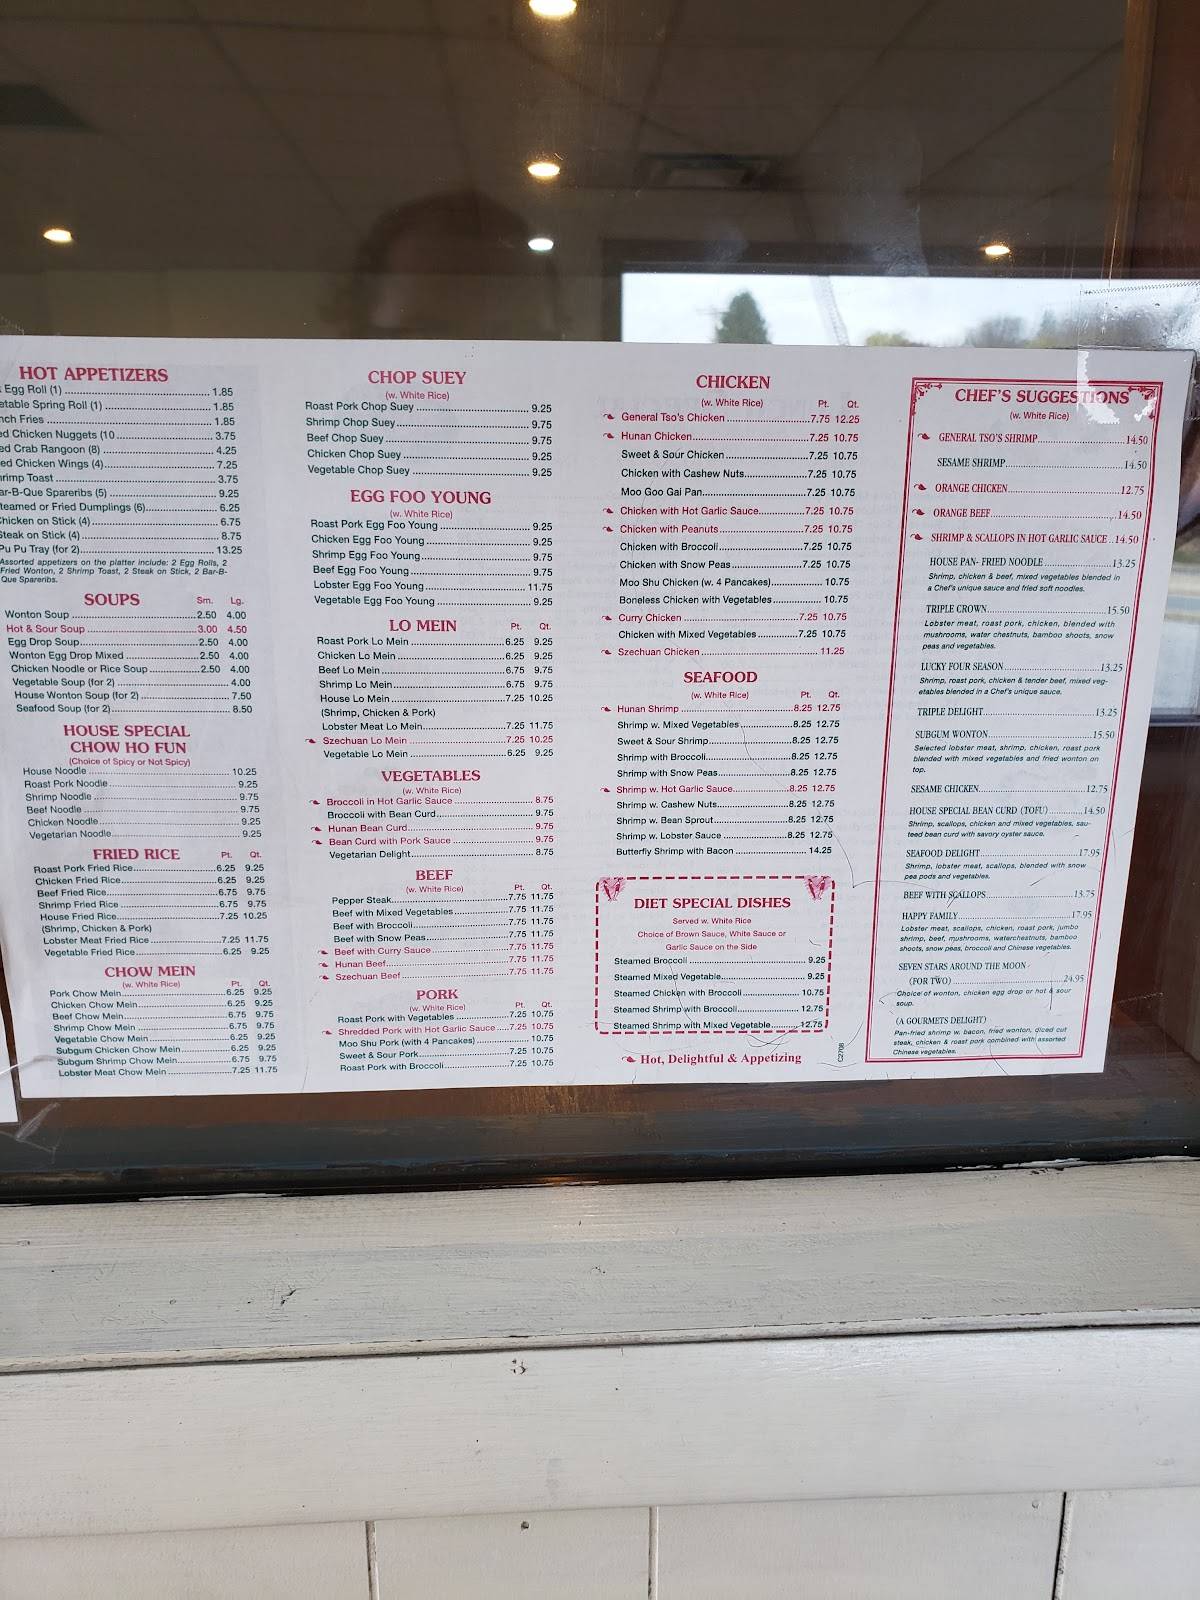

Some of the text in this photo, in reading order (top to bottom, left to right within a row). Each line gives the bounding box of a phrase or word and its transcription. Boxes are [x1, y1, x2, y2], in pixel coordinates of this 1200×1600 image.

[18, 365, 169, 383] HOT APPETIZERS
[367, 370, 467, 385] CHOP SUEY
[695, 374, 771, 390] CHICKEN
[385, 390, 450, 402] (w. White Rice)
[954, 387, 1130, 405] CHEF'S SUGGESTIONS
[621, 411, 860, 425] General Tso's Chicken 7.75 12.25
[938, 432, 1149, 447] GENERAL TSO'S SHRIMP 14.50
[13, 443, 39, 454] Crab
[40, 443, 86, 456] Rangoon
[87, 444, 101, 456] (8)
[215, 445, 237, 456] 4.25
[350, 489, 492, 505] EGG FOO YOUNG
[929, 557, 959, 567] HOUSE
[981, 557, 1007, 567] FRIED
[1008, 557, 1044, 568] NOODLE
[1112, 558, 1136, 569] 13.25
[313, 579, 553, 593] Lobster Egg Foo Young 11.75
[933, 583, 957, 592] Chef's
[957, 584, 982, 593] unique
[1005, 583, 1021, 592] and
[1021, 584, 1039, 593] fried
[1039, 584, 1054, 592] soft
[1054, 584, 1085, 593] noodles.
[83, 593, 245, 607] SOUPS Sm. Lg.
[5, 623, 248, 636] Hot & Sour Soup 3.00 4.50
[389, 619, 552, 633] LO MEIN Pt. Qt.
[618, 629, 847, 641] Chicken with Mixed Vegetables 7.25 10.75
[317, 650, 554, 661] Chicken Lo Mein 6.25 9.25
[10, 663, 251, 675] Chicken Noodle or Rice Soup 2.50 4.00
[683, 671, 758, 684] SEAFOOD
[63, 724, 191, 738] HOUSE SPECIAL
[70, 741, 187, 754] CHOW HO FUN
[68, 757, 191, 768] (Choice of Spicy or Not Spicy)
[381, 769, 481, 783] VEGETABLES
[326, 795, 554, 807] Broccoli in Hot Garlic Sauce 8.75
[92, 848, 262, 861] FRIED RICE Pt. Qt.
[616, 846, 832, 857] Butterfly Shrimp with Bacon 14.25
[33, 863, 265, 875] Roast Pork Fried Rice 6.25 9.25
[415, 869, 454, 881] BEEF
[331, 892, 554, 906] Pepper Steak 7.75 11.75
[633, 897, 792, 910] DIET SPECIAL DISHES
[672, 917, 700, 925] Served
[711, 917, 734, 925] White
[734, 917, 752, 925] Rice
[901, 909, 1093, 921] HAPPY FAMILY 17.95
[104, 965, 196, 979] CHOW MEIN
[898, 961, 1027, 971] SEVEN STARS AROUND THE MOON
[613, 972, 825, 982] Steamed Mixed Vegetable 9.25
[416, 988, 459, 1001] PORK
[338, 1033, 554, 1048] Moo Shu Pork (with 4 Pancakes) 10.75
[640, 1051, 802, 1066] Hot, Delightful & Appetizing
[58, 1065, 278, 1078] Lobster Meat Chow Mein 7.25 11.75
